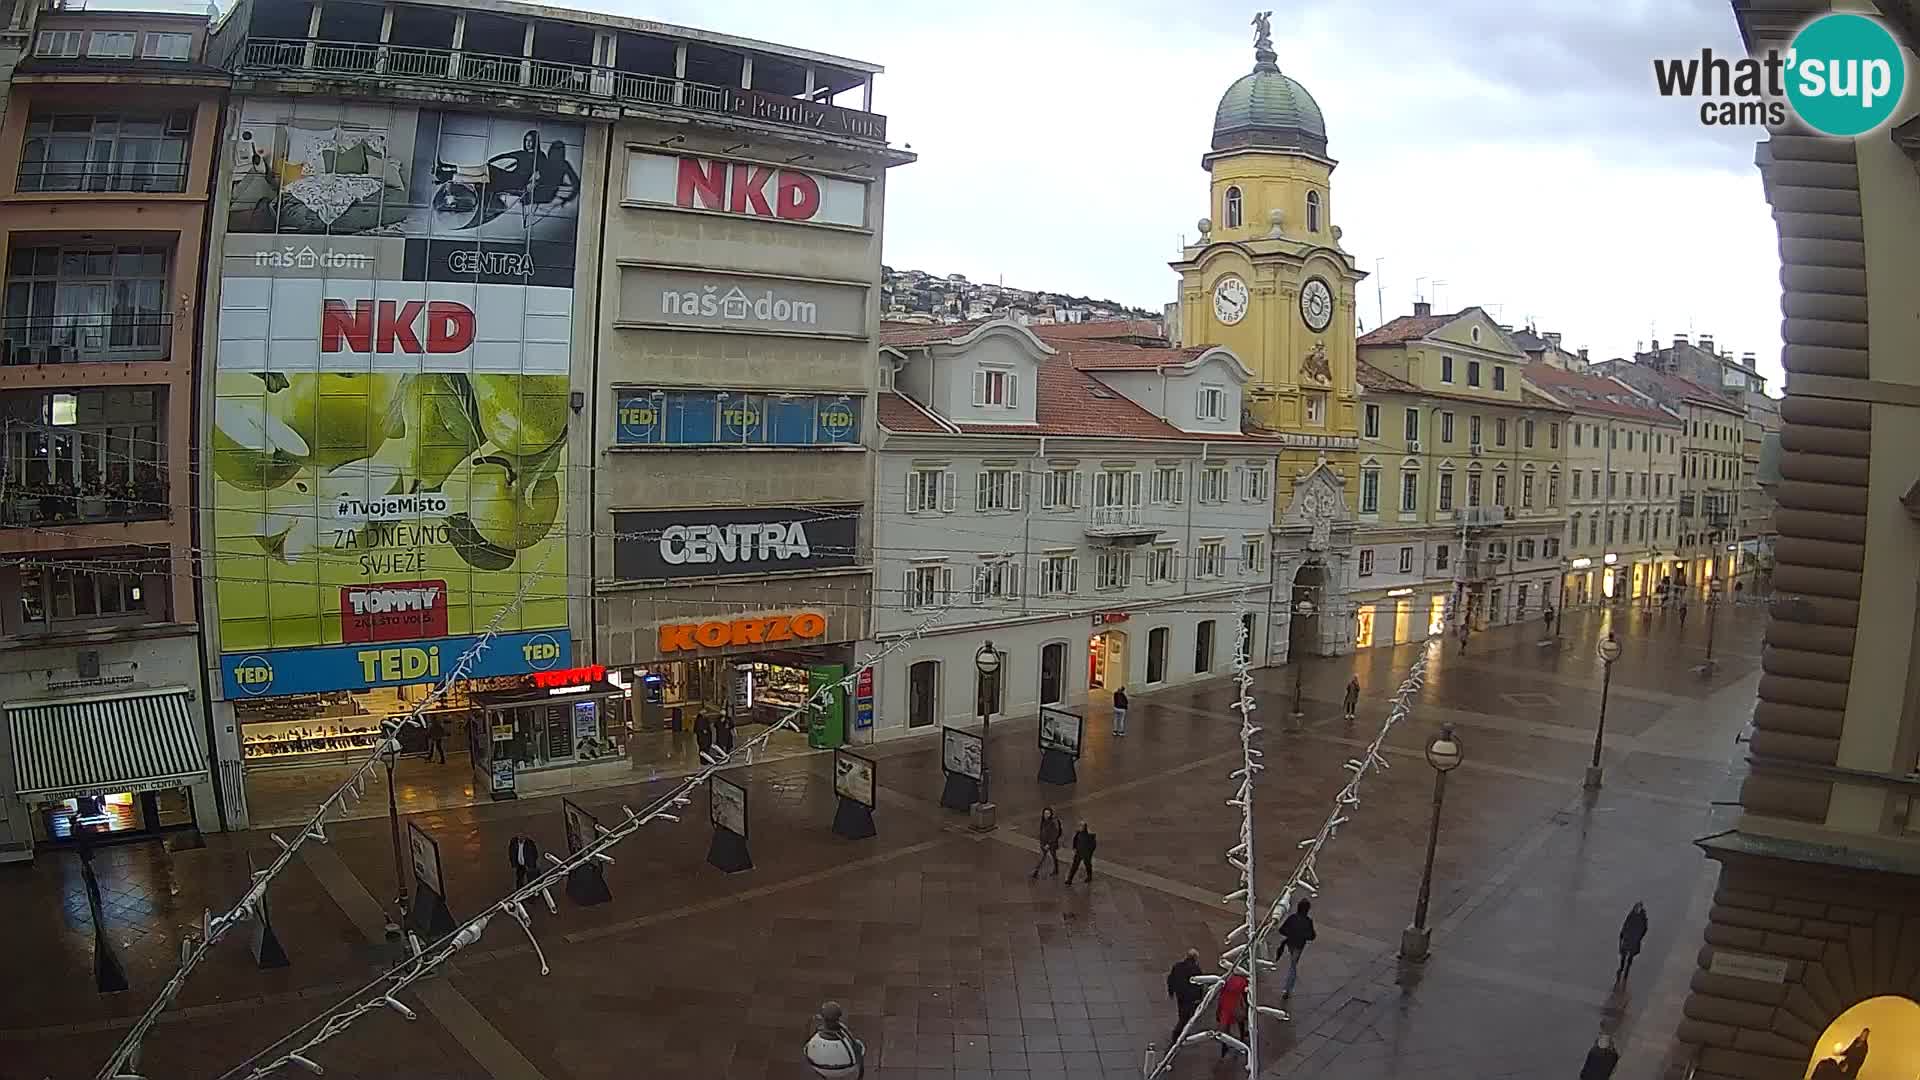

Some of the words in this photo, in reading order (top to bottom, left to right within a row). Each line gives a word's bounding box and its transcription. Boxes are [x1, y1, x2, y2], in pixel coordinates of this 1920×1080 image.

[723, 89, 746, 111] Le
[676, 158, 820, 220] NKD
[255, 246, 295, 268] naš
[320, 247, 366, 268] dom
[449, 250, 535, 276] CENTRA
[662, 285, 718, 316] naš
[754, 290, 817, 323] dom
[321, 298, 477, 353] NKD
[619, 408, 658, 426] TEDi
[723, 409, 760, 426] TEDi
[821, 411, 854, 427] TEDi
[338, 498, 446, 516] #TvojeMisto
[334, 529, 358, 549] ZA
[366, 524, 449, 548] DNEVNO
[659, 522, 810, 564] CENTRA
[360, 547, 427, 575] SVJEŽE
[350, 587, 439, 615] TOMMY
[659, 613, 825, 652] KORZO
[358, 646, 440, 682] TEDi
[523, 643, 560, 661] TEDi
[234, 666, 274, 683] TEDi
[150, 778, 182, 790] CENTAR
